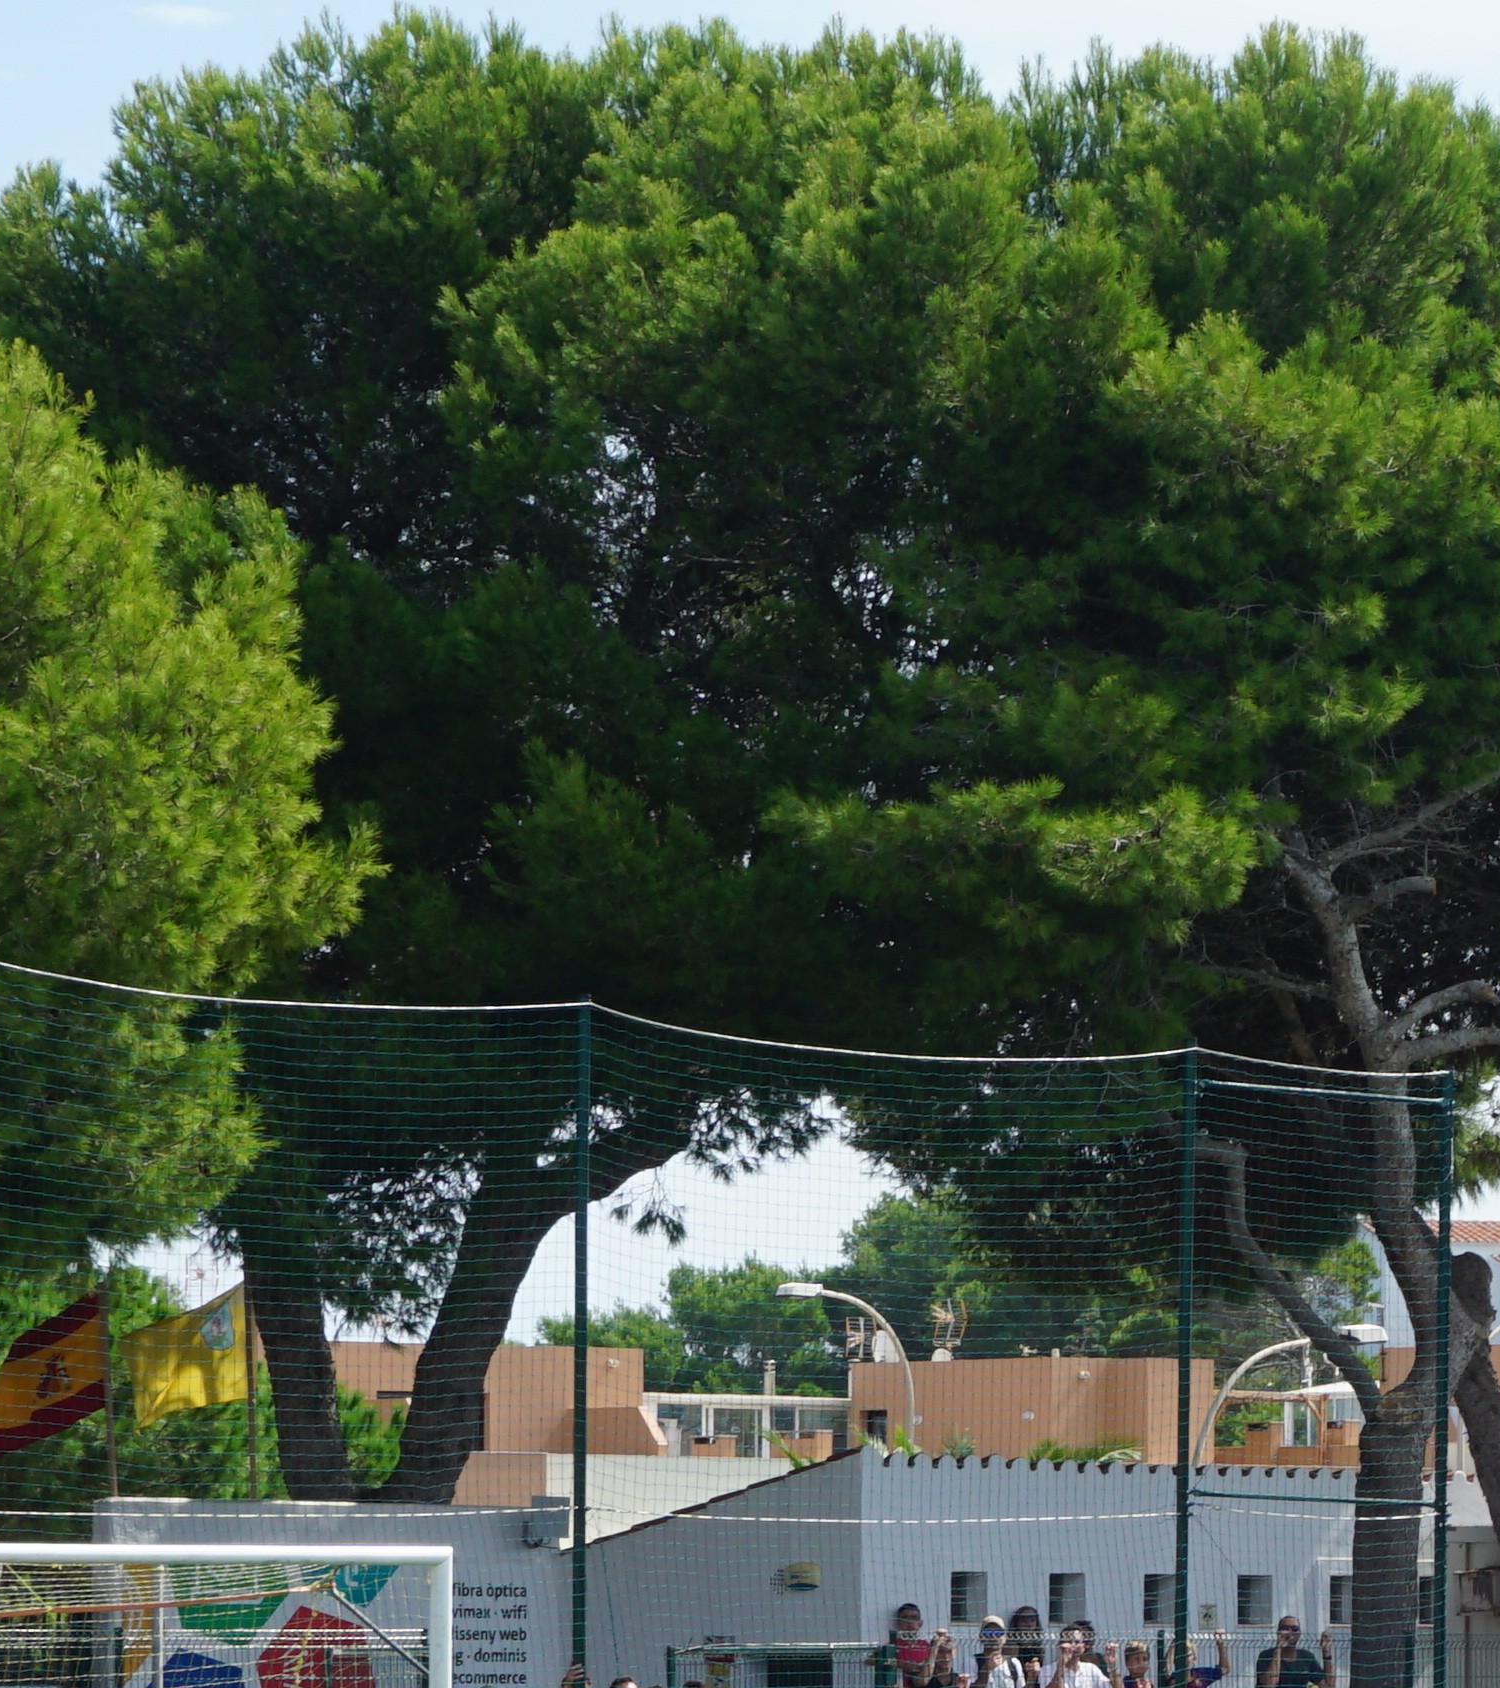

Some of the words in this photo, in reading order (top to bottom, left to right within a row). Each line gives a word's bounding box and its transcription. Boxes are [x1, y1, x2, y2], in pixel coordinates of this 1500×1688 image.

[501, 1604, 528, 1619] wifi
[452, 1626, 496, 1644] isseny
[499, 1627, 527, 1641] web
[474, 1648, 527, 1663] dominis
